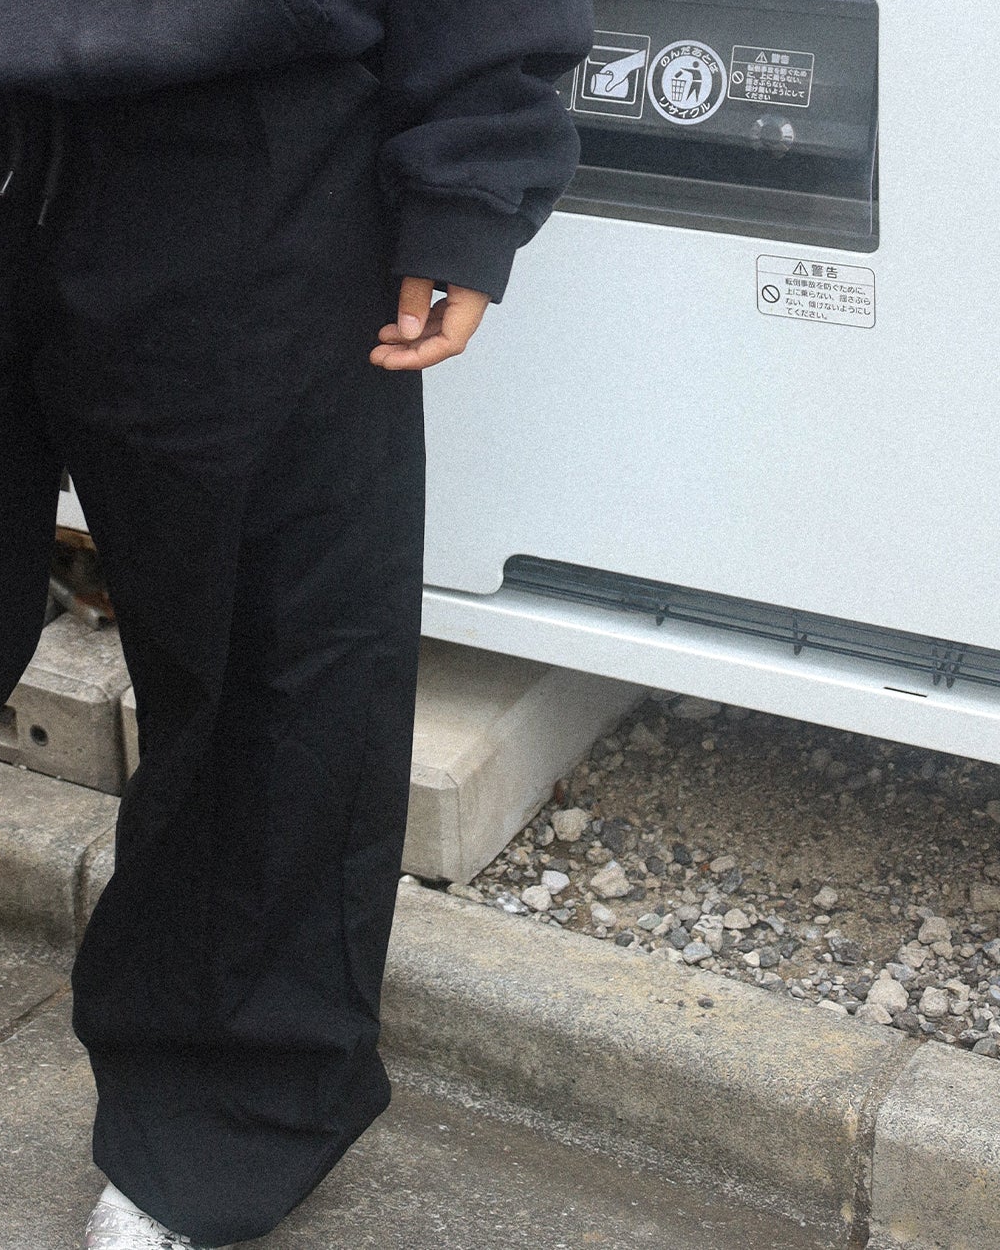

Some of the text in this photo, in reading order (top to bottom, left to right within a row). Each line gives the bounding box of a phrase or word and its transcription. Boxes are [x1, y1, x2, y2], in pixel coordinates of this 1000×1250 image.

[660, 45, 719, 74] のんだあとは
[659, 97, 711, 119] リサイクル
[811, 264, 838, 279] 警告
